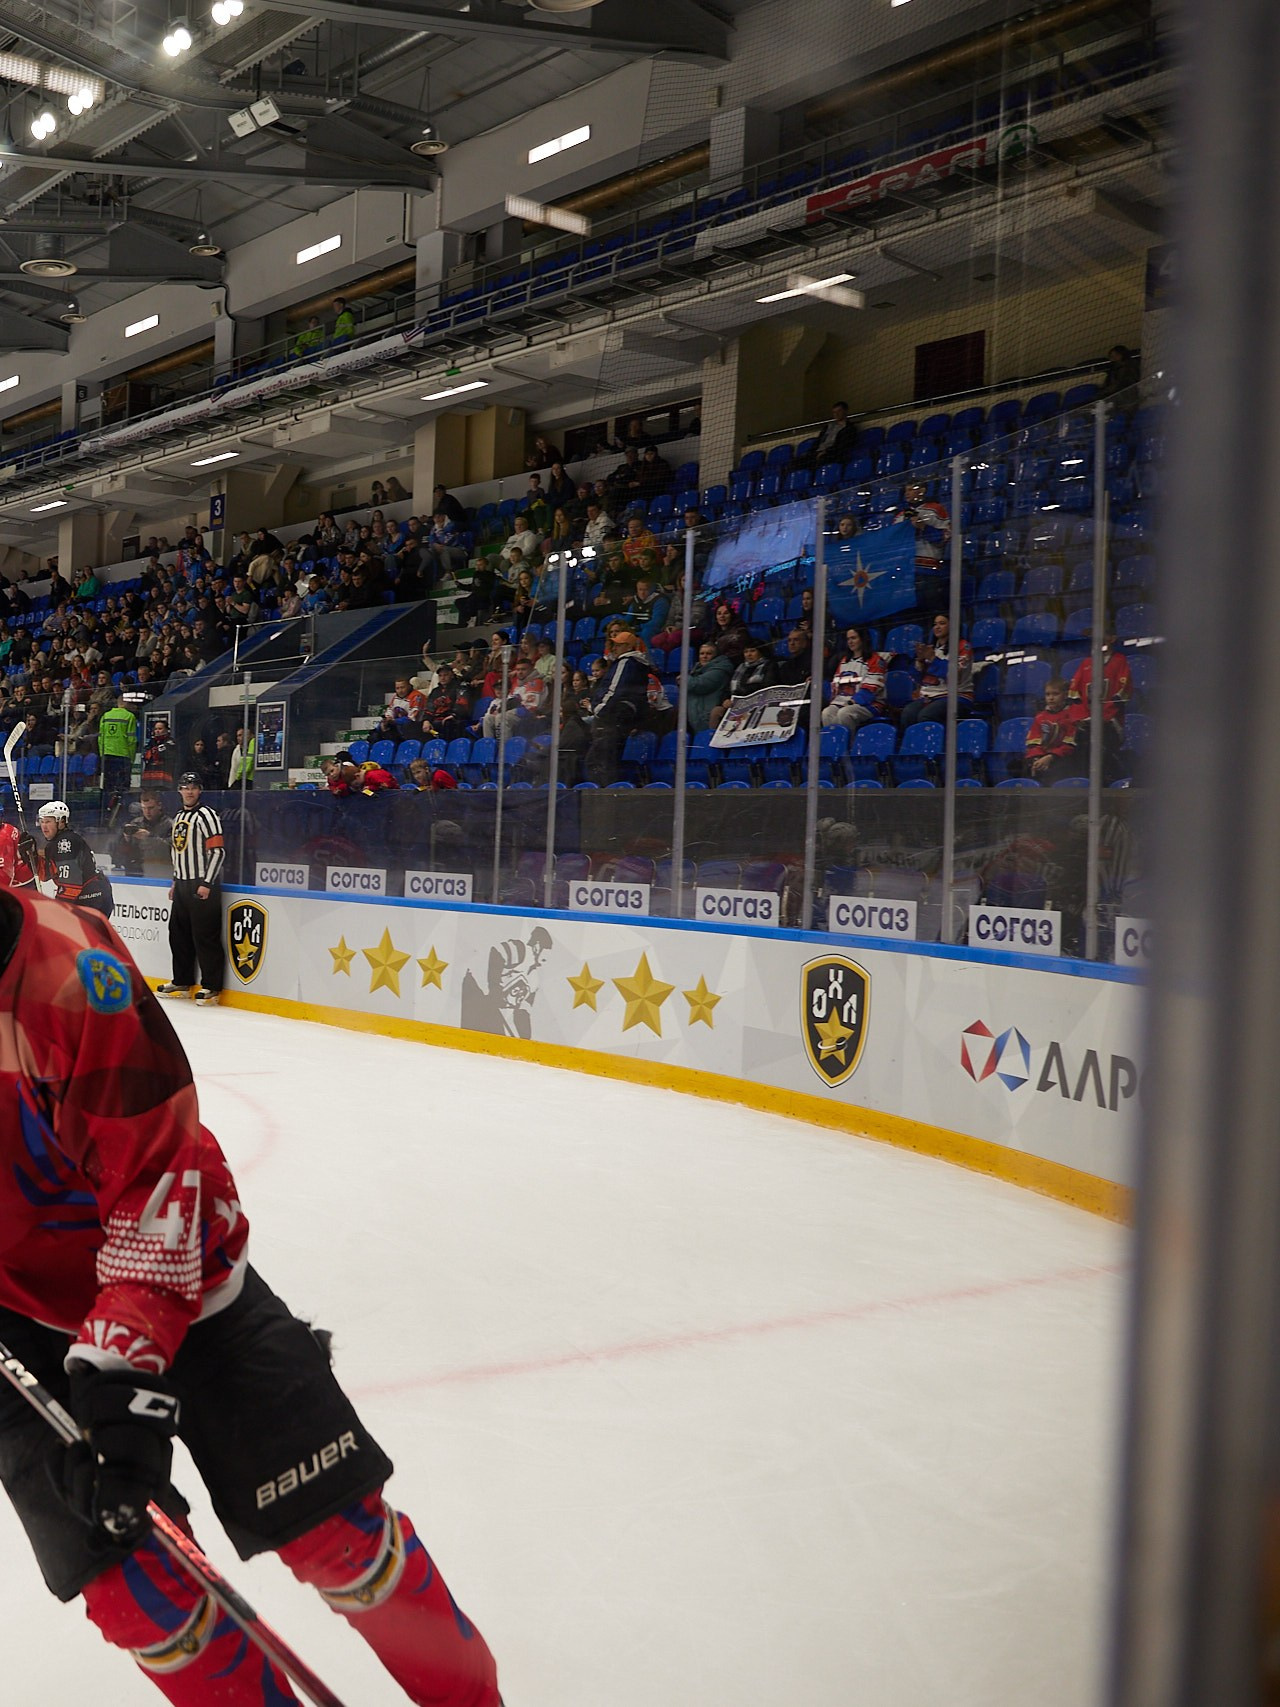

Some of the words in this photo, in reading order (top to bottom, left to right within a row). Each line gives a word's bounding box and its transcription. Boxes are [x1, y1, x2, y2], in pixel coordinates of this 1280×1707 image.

[214, 499, 222, 516] 3
[113, 903, 169, 922] ТЕЛЬСТВО
[256, 1430, 360, 1510] BAUER
